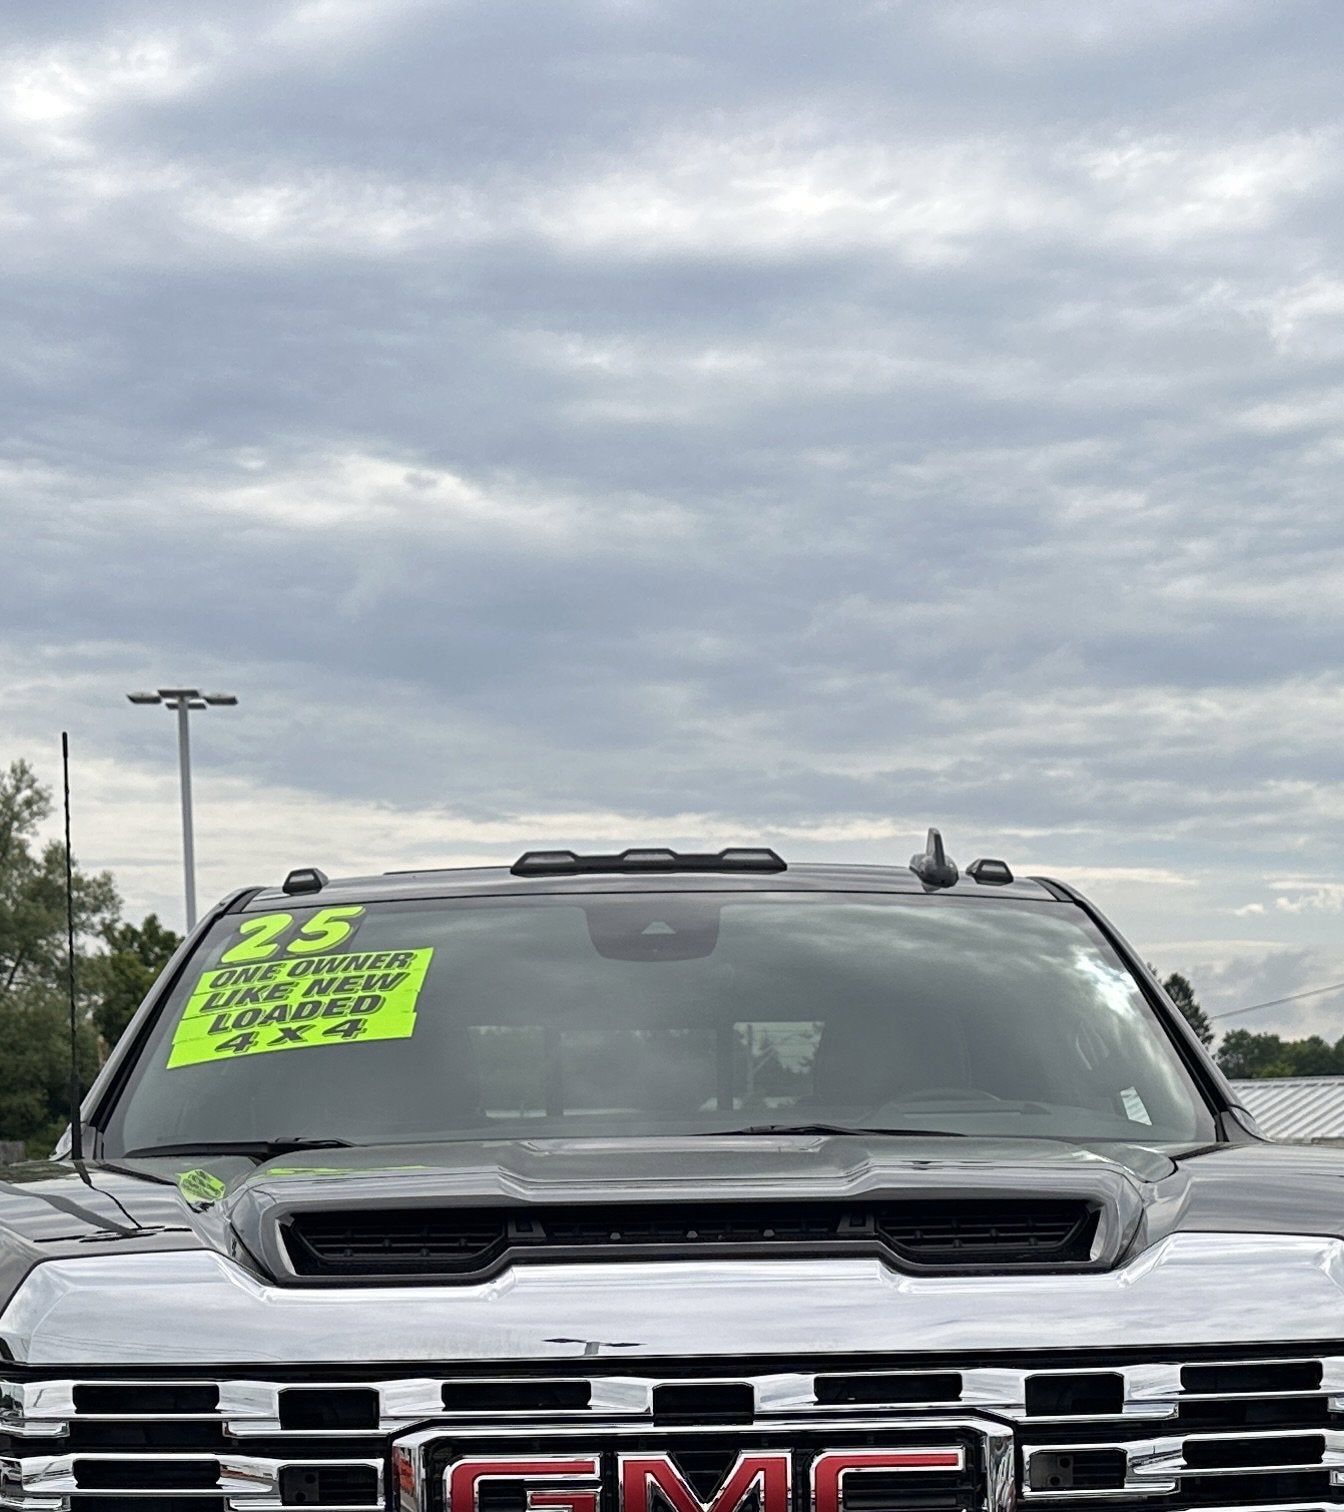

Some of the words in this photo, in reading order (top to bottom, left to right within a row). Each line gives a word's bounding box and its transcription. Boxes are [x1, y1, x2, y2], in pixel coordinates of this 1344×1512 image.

[221, 906, 365, 963] 25
[209, 962, 287, 989] ONE
[287, 952, 418, 978] OWNER
[200, 981, 300, 1013] LIKE
[302, 972, 410, 998] NEW
[207, 994, 386, 1035] LOADED
